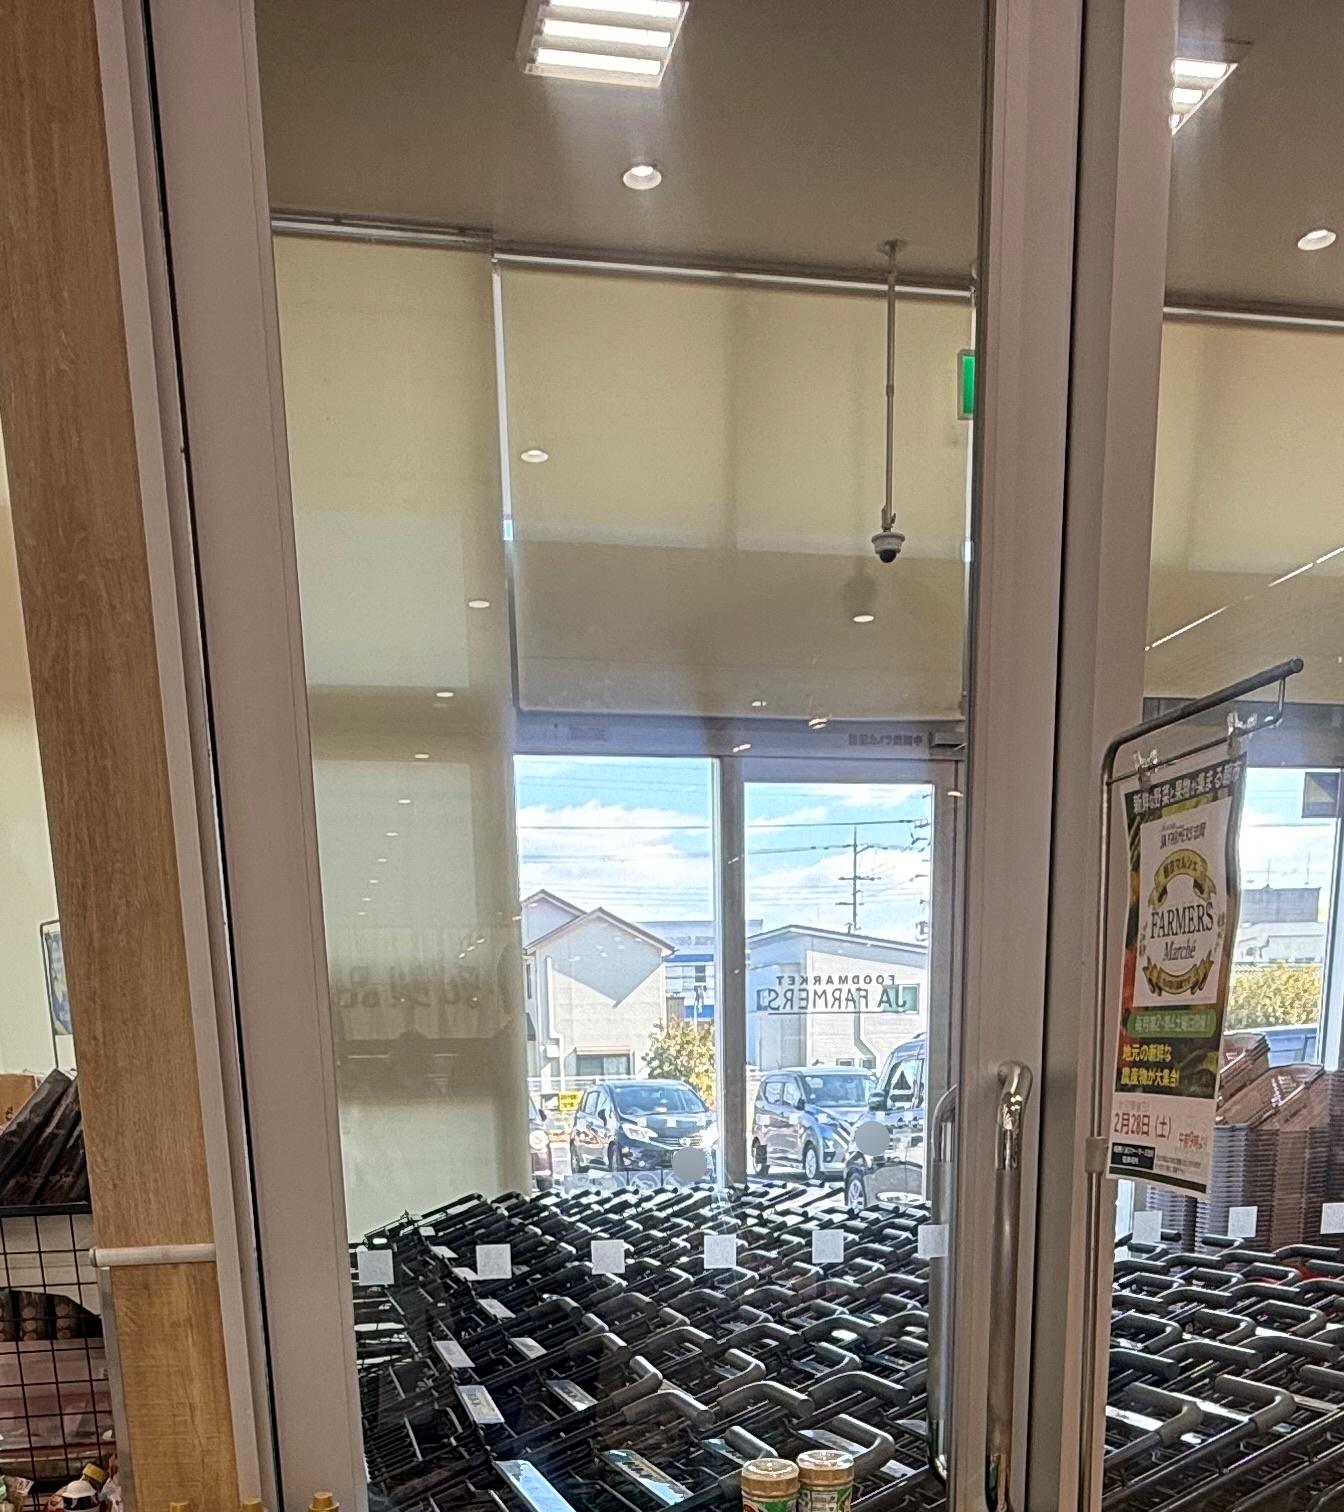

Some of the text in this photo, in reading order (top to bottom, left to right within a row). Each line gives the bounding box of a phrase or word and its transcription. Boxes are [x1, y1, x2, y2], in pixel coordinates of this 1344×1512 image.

[1150, 901, 1214, 939] FARMERS
[1163, 938, 1197, 961] Marché
[1122, 1044, 1172, 1062] 地元の新鮮な
